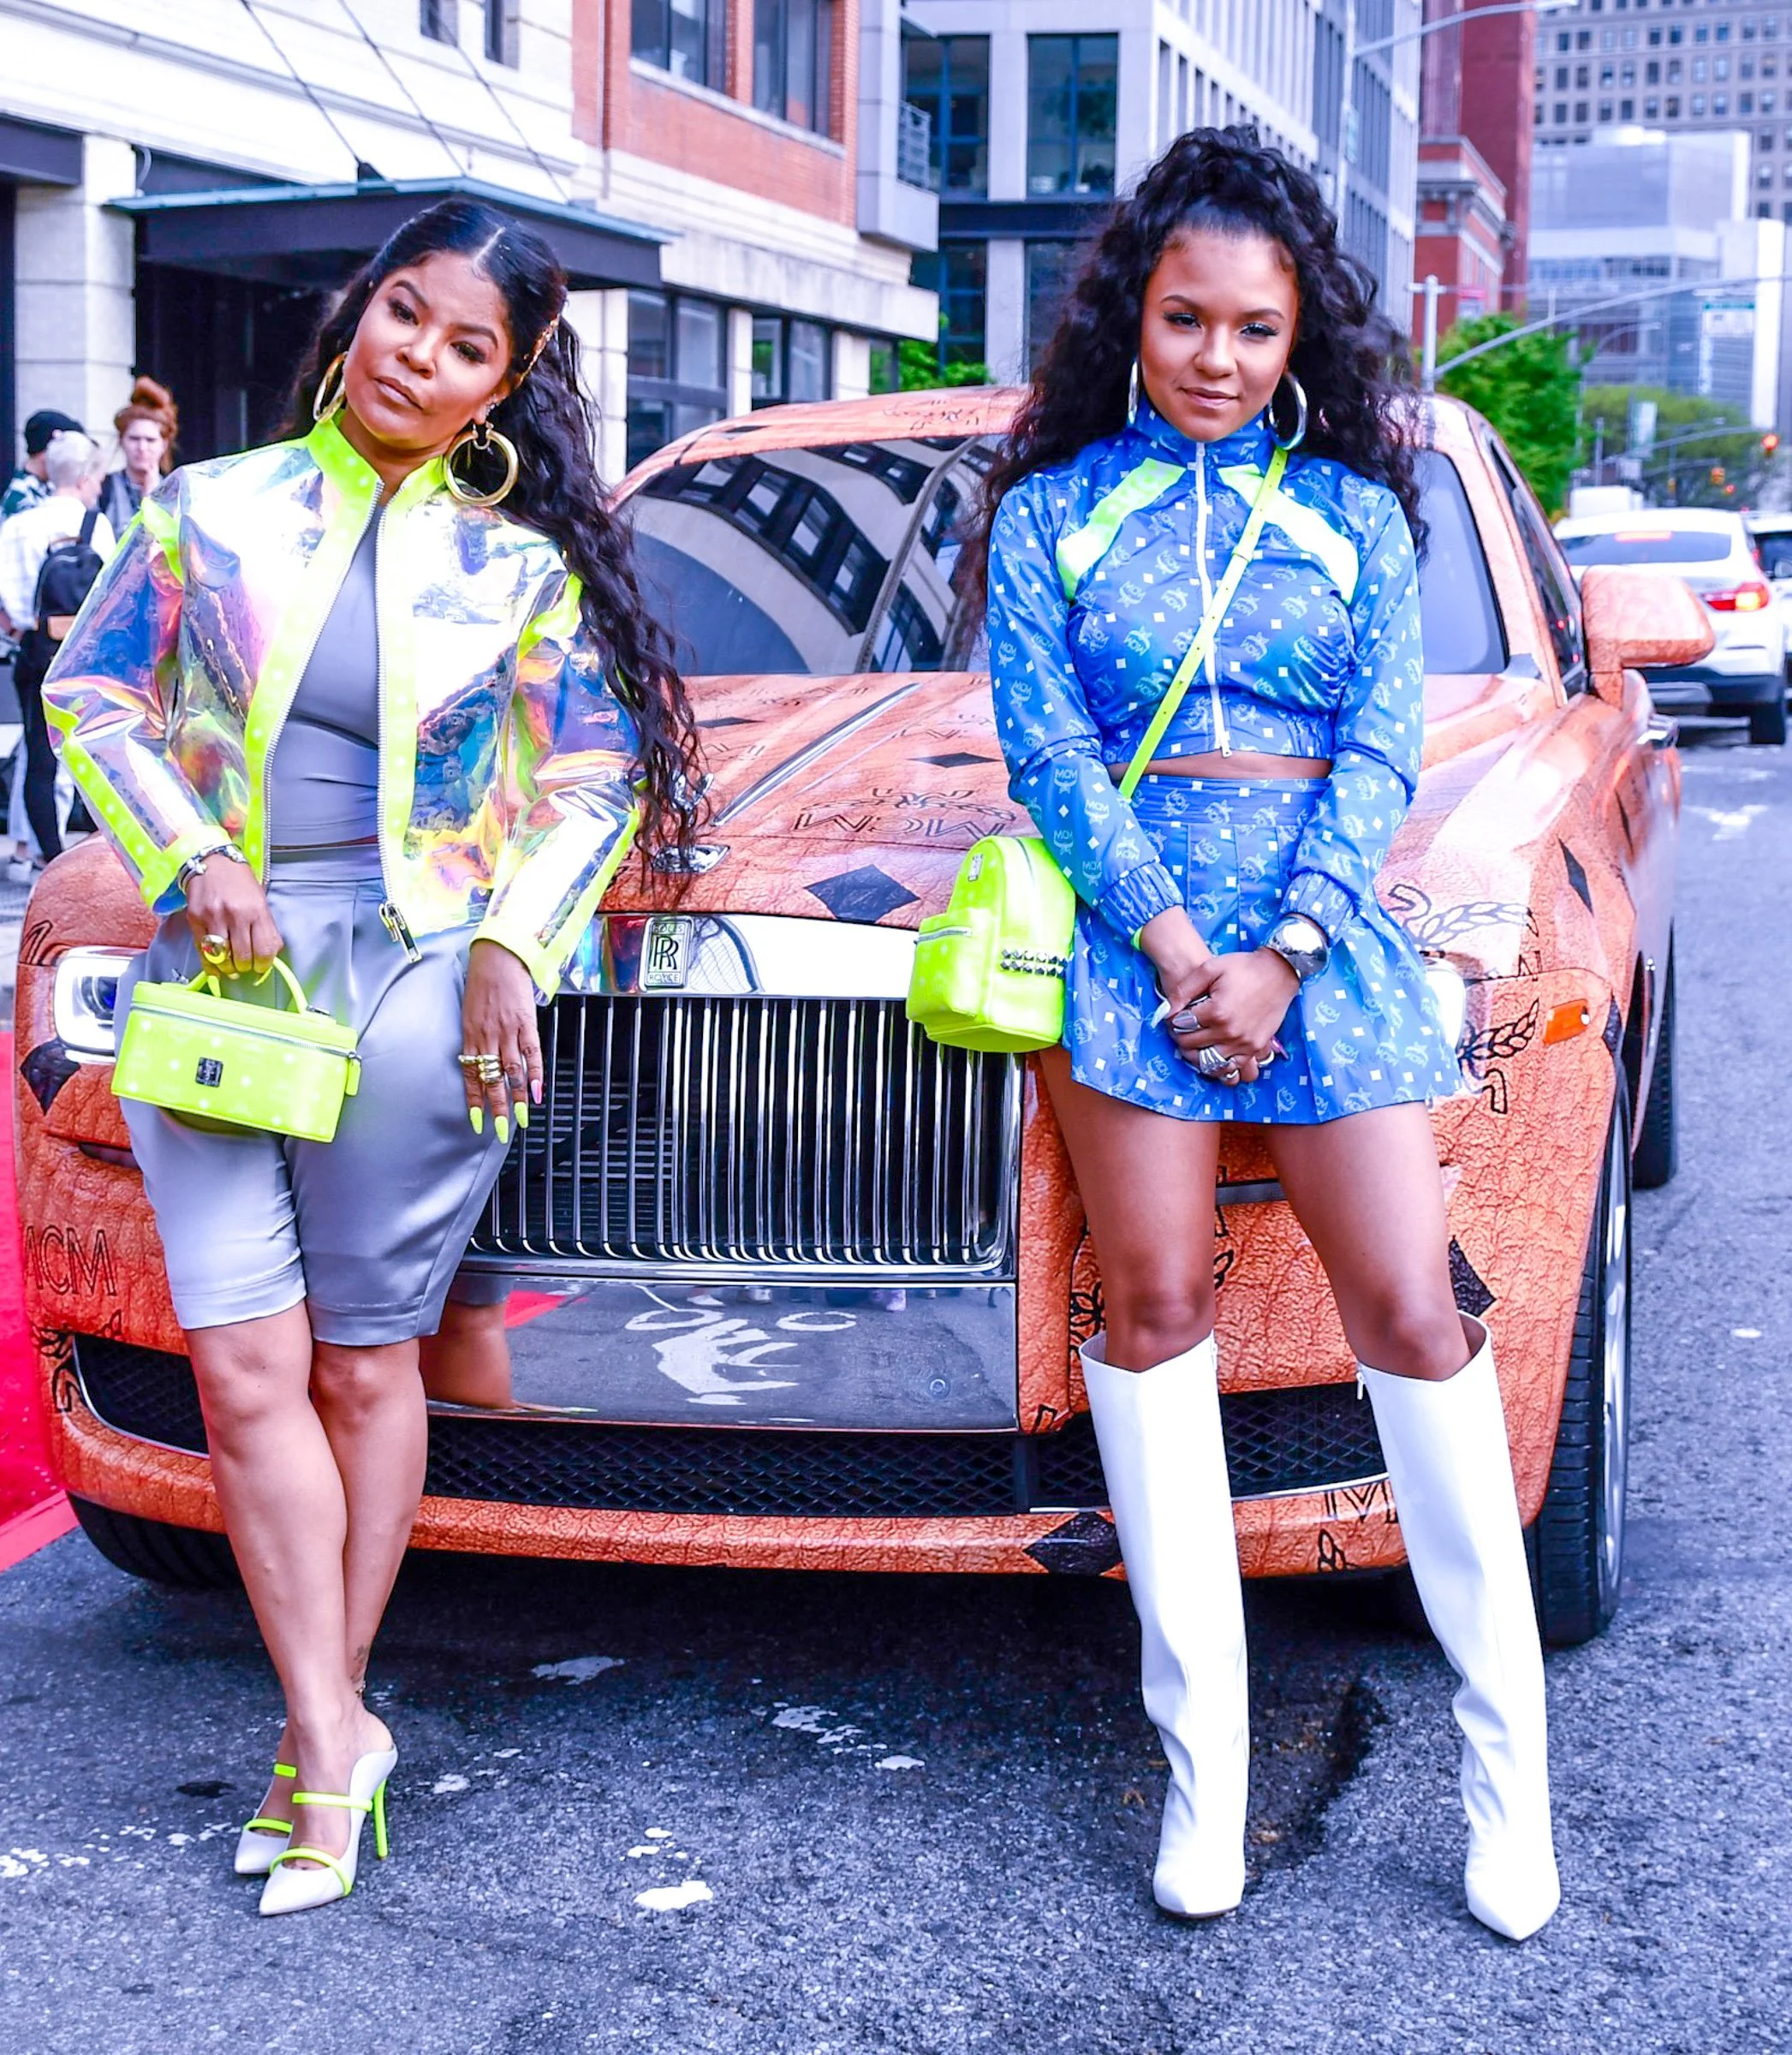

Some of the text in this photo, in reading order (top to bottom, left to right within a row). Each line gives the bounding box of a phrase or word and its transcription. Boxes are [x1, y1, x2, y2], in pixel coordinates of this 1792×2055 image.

[1124, 581, 1146, 599] MCM
[1124, 639, 1146, 656] MCM
[1014, 680, 1033, 694] MCM
[1253, 678, 1277, 698] MCM
[1054, 769, 1077, 780] MCM
[1086, 799, 1109, 813] MCM
[1199, 838, 1222, 858] MCM
[1082, 861, 1103, 871] MCM
[1242, 864, 1262, 883] MCM
[653, 936, 679, 970] RR
[1321, 1001, 1341, 1018] MCM
[1338, 1040, 1359, 1060] MCM
[1152, 1055, 1171, 1077] MCM
[1281, 1087, 1297, 1107] MCM
